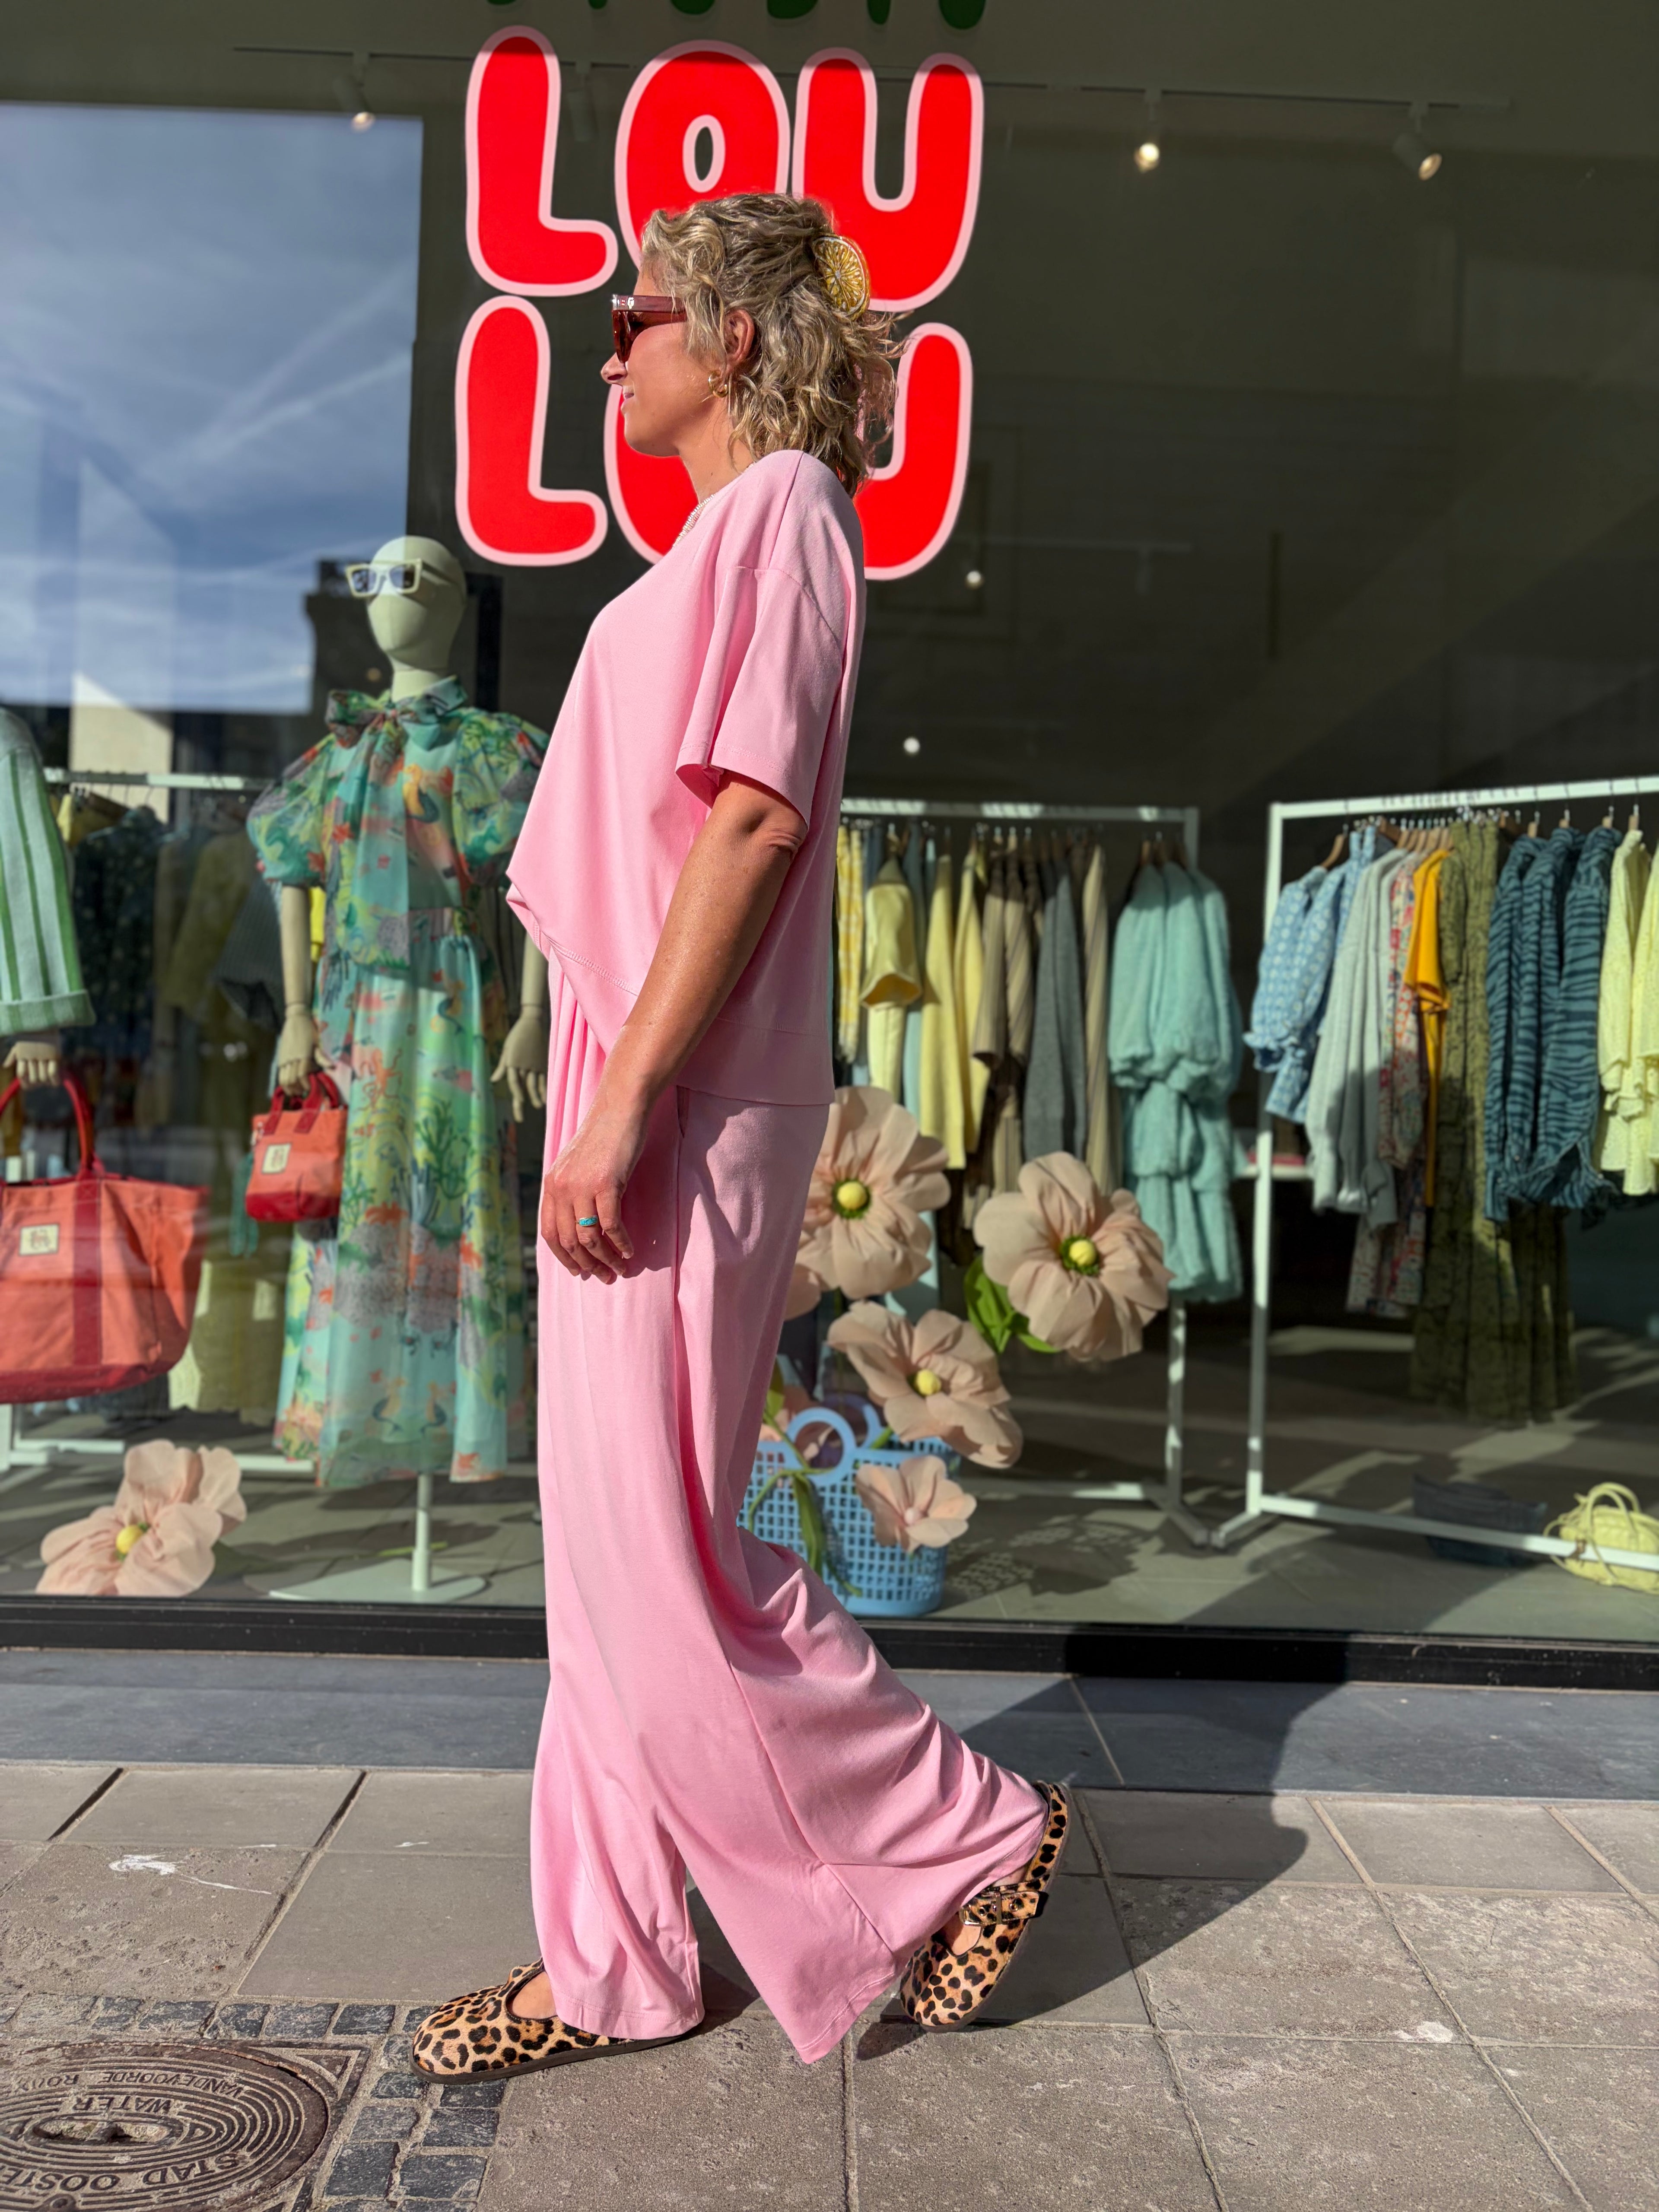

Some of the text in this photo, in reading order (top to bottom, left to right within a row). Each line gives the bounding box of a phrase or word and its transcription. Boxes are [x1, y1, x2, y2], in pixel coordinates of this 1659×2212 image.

[465, 25, 984, 312] LOU
[98, 2072, 246, 2099] VANDEVOORDE
[72, 2096, 174, 2114] WATER
[0, 2154, 240, 2192] STAD OOSTE
